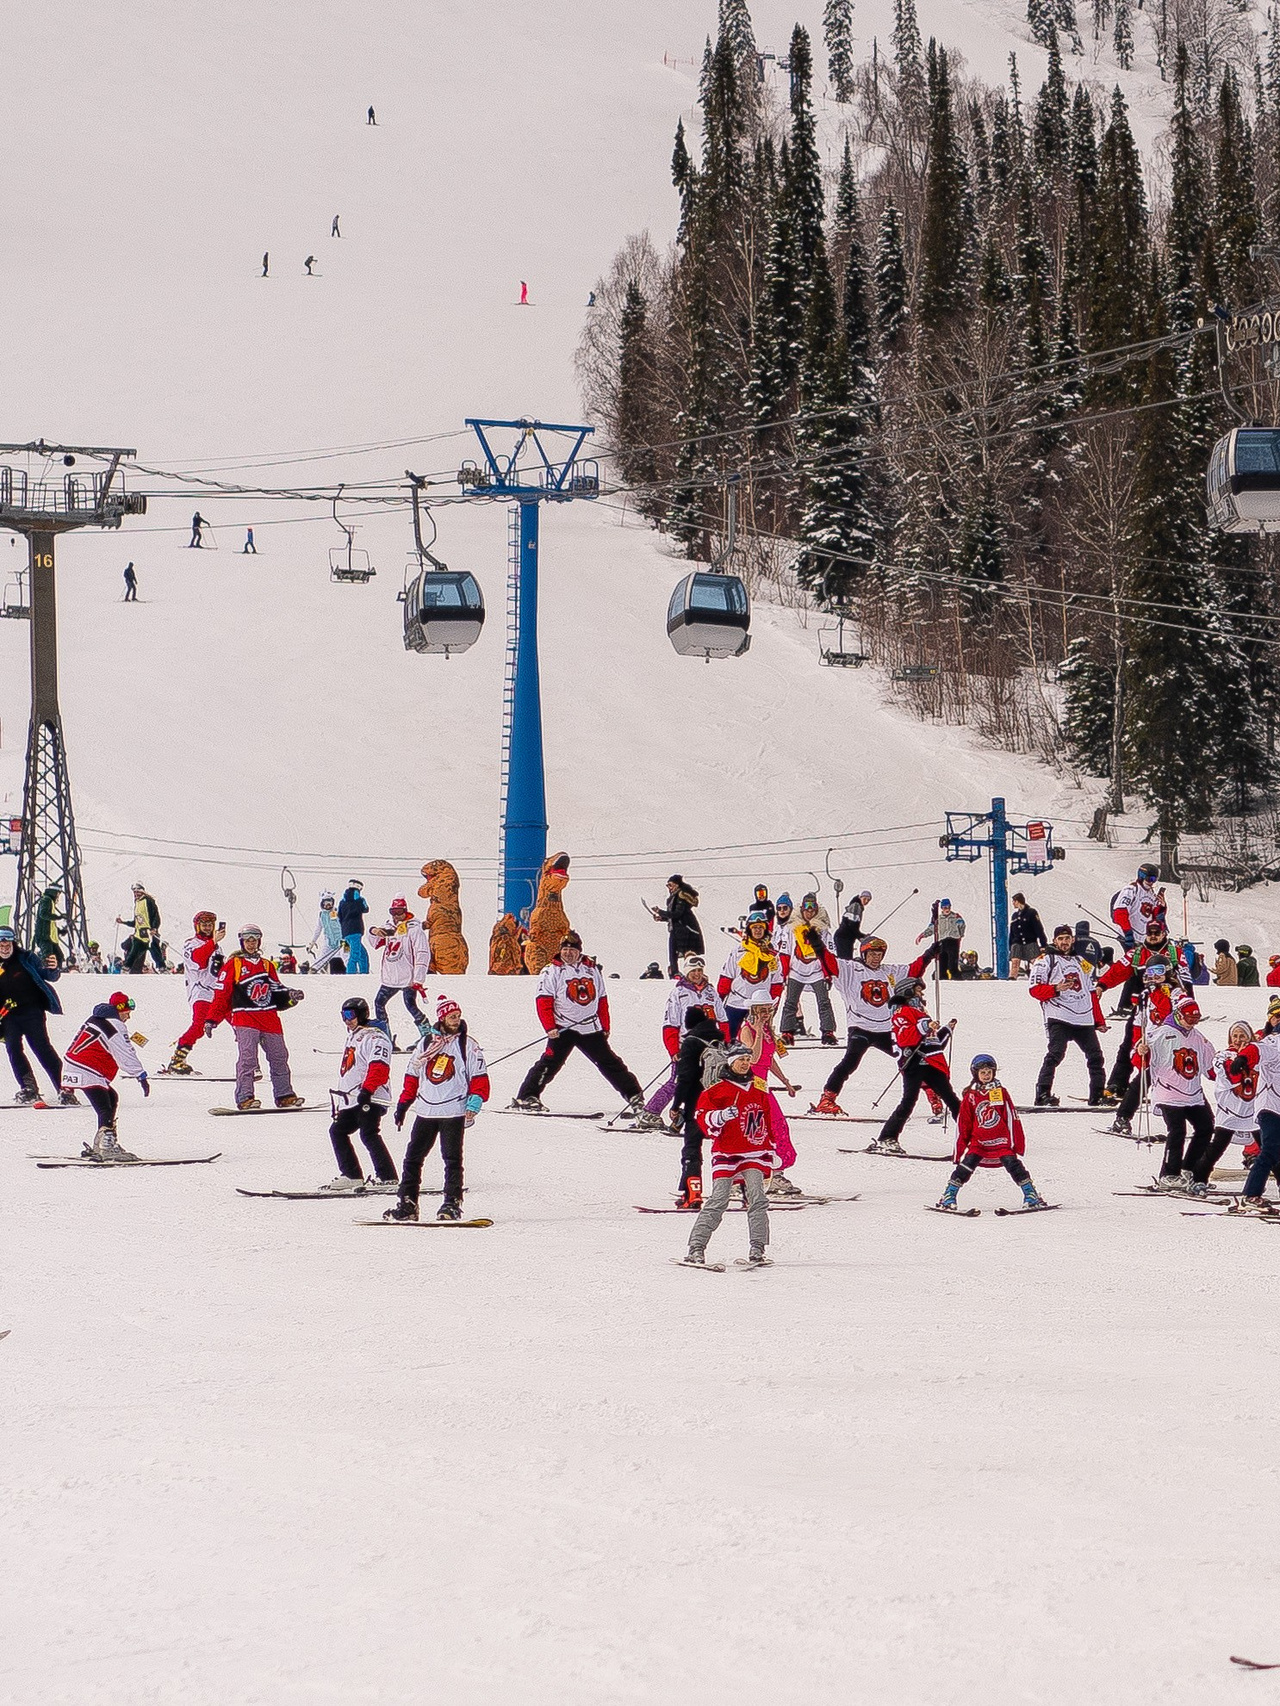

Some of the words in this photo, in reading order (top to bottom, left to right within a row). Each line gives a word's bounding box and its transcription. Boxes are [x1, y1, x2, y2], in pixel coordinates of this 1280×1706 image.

[34, 553, 54, 568] 16
[373, 1045, 389, 1059] 26
[62, 1074, 79, 1084] РАЗ
